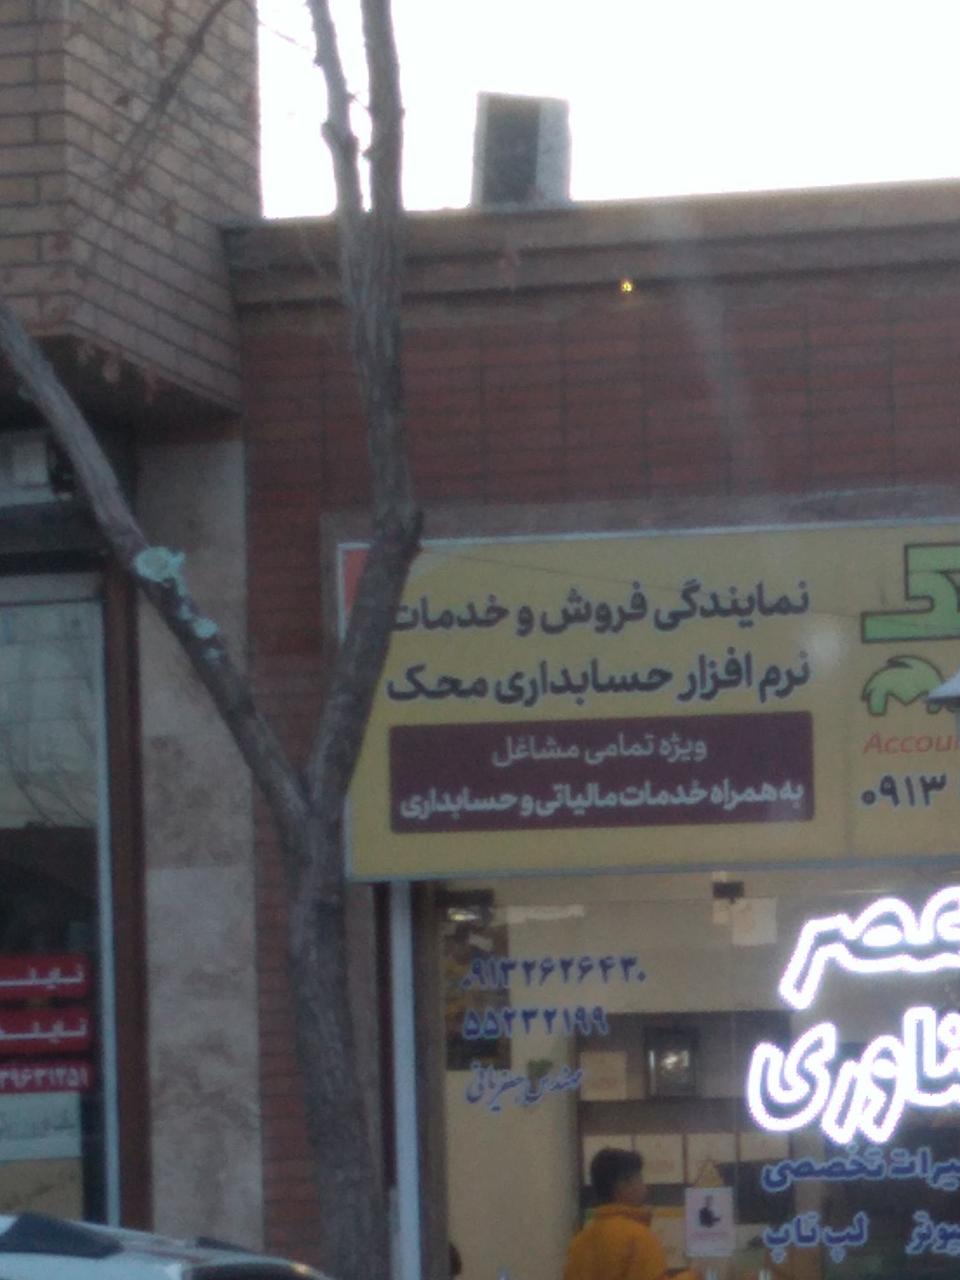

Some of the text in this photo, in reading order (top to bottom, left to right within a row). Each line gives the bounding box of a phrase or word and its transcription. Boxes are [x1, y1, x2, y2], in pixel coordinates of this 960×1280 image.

[393, 579, 811, 636] نمایندگی فروش و خدمات
[386, 646, 811, 707] نرم افزار حسابداری محک
[491, 733, 708, 768] ویژه تمامی مشاغل
[399, 786, 519, 821] حسابداری
[535, 782, 618, 817] مالیاتی
[618, 779, 709, 807] خدمات
[861, 772, 946, 808] ۰۹۱۳
[461, 955, 647, 991] ۰۹۱۳۲۶۲۶۴۳۰
[761, 1146, 888, 1192] تخصصی
[763, 1211, 821, 1264] تاپ
[821, 1211, 869, 1264] لپ
